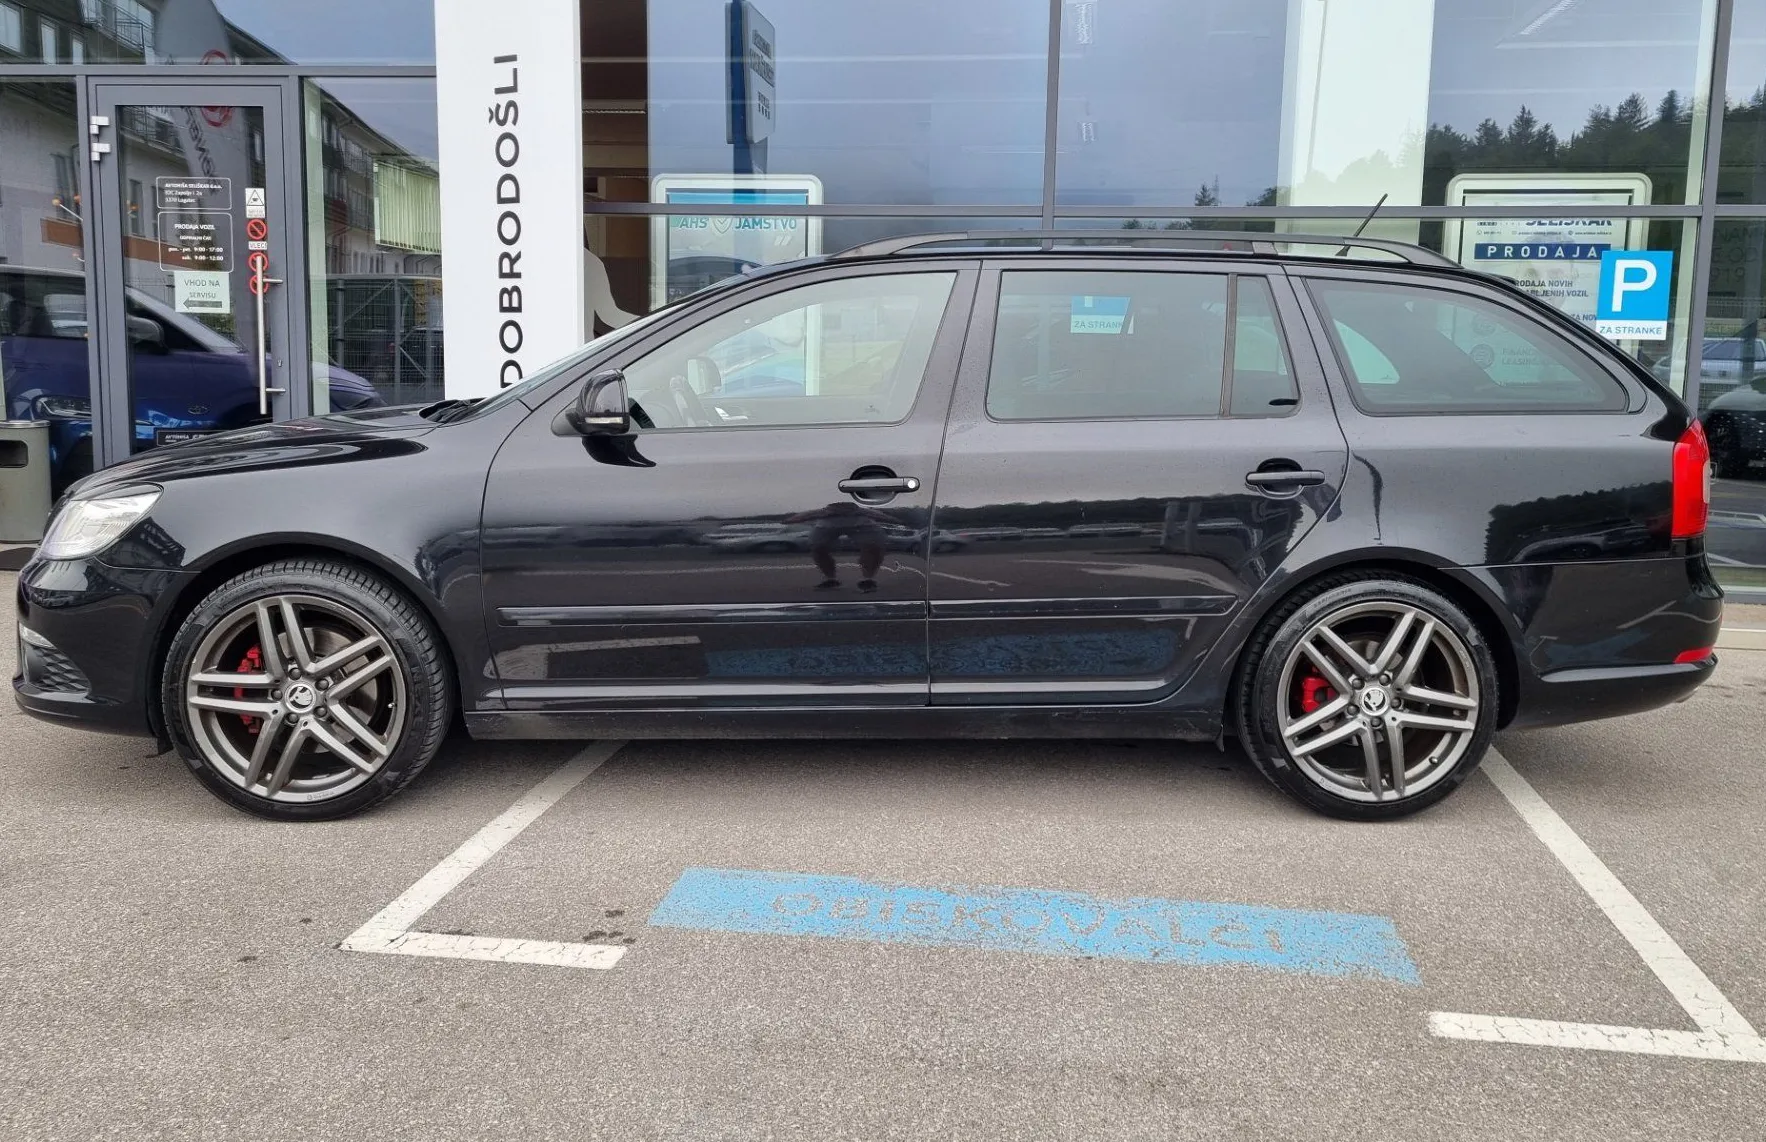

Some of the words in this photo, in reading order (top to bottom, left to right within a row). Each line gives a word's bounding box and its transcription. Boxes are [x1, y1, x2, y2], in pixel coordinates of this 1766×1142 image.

[488, 54, 523, 389] DOBRODOŠLI
[679, 217, 708, 229] AHS
[735, 217, 797, 230] JAMSTVO
[1487, 245, 1598, 258] PRODAJA
[184, 279, 207, 287] VHOD
[1611, 259, 1658, 312] P
[1526, 289, 1564, 297] BLJENIH
[1073, 320, 1086, 328] ZA
[1600, 326, 1613, 334] ZA
[1615, 326, 1662, 335] STRANKE
